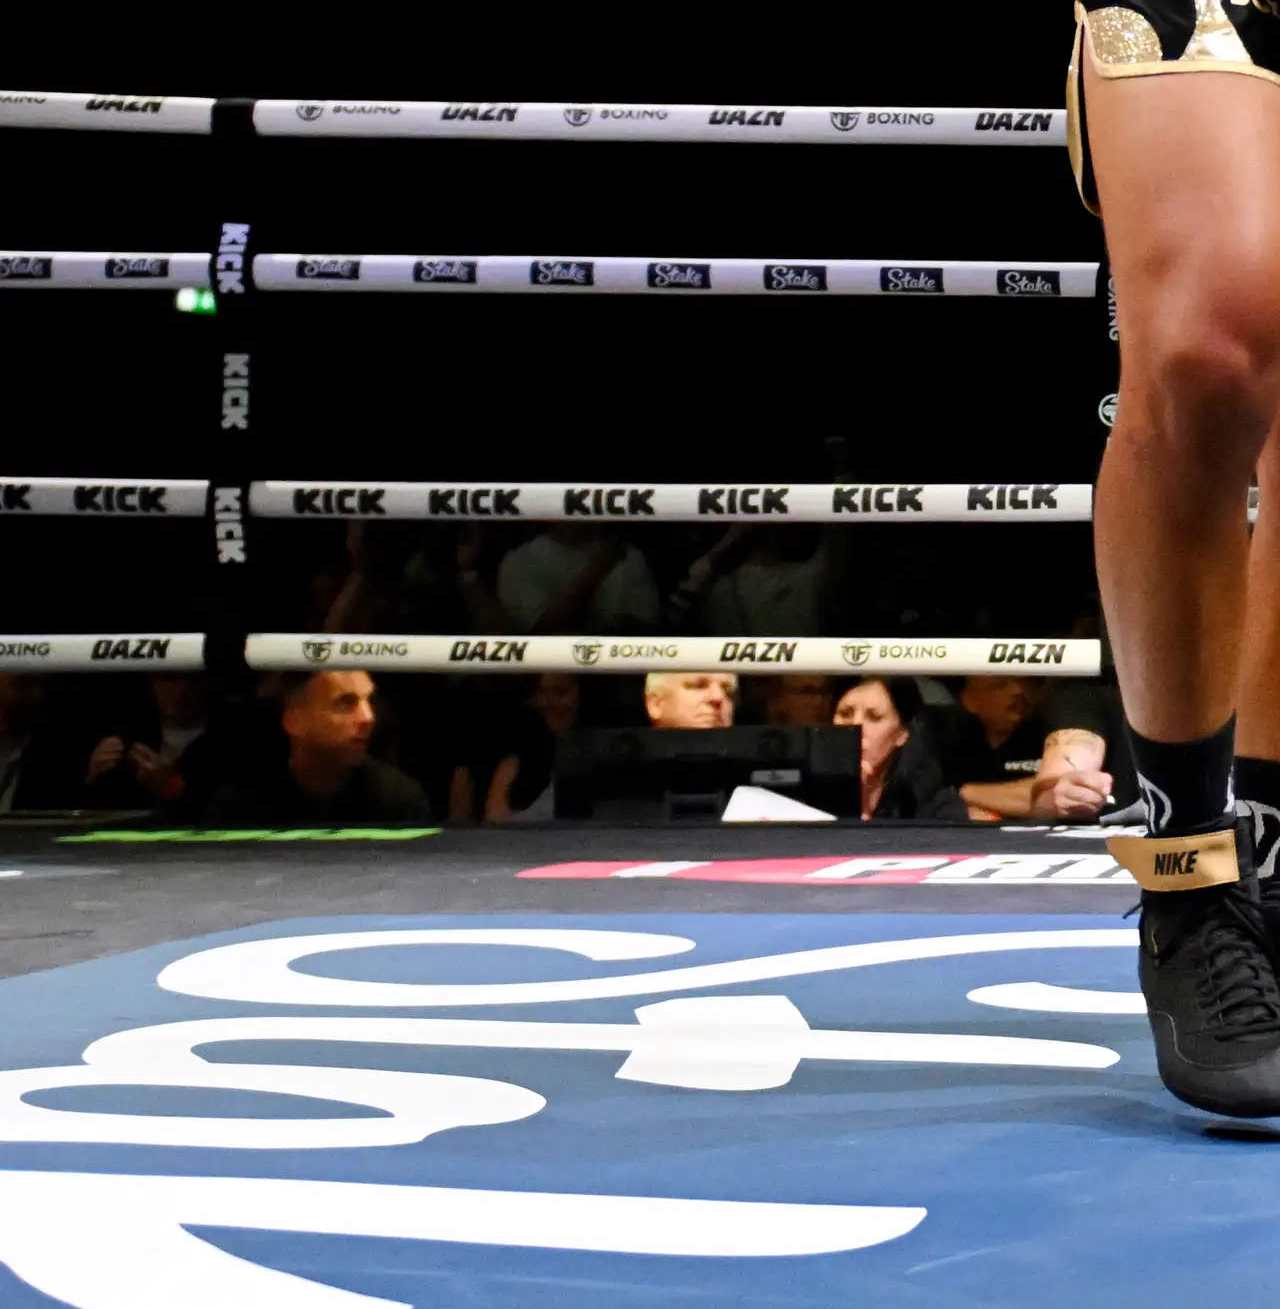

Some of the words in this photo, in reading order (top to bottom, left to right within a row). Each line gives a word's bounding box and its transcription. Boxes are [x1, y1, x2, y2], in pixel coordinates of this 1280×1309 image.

[708, 110, 785, 128] DAZN
[867, 113, 935, 128] BOXING
[975, 113, 1053, 133] DAZN
[216, 223, 250, 294] KICK
[419, 260, 470, 281] Stake
[537, 261, 588, 283] Stake
[654, 263, 705, 286] Stake
[771, 265, 820, 289] Stake
[887, 268, 937, 292] Stake
[1003, 271, 1053, 294] Stake
[221, 353, 250, 430] KICK
[74, 486, 166, 512] KICK
[293, 488, 387, 515] KICK
[429, 489, 520, 515] KICK
[564, 488, 655, 515] KICK
[698, 487, 789, 514] KICK
[832, 487, 923, 513] KICK
[967, 485, 1058, 510] KICK
[214, 487, 247, 564] KICK
[0, 642, 50, 657] OXING
[91, 639, 170, 661] DAZN
[340, 642, 408, 657] BOXING
[449, 640, 529, 662] DAZN
[609, 643, 678, 659] BOXING
[719, 642, 798, 663] DAZN
[879, 644, 947, 659] BOXING
[988, 643, 1067, 664] DAZN
[1154, 850, 1199, 875] NIKE
